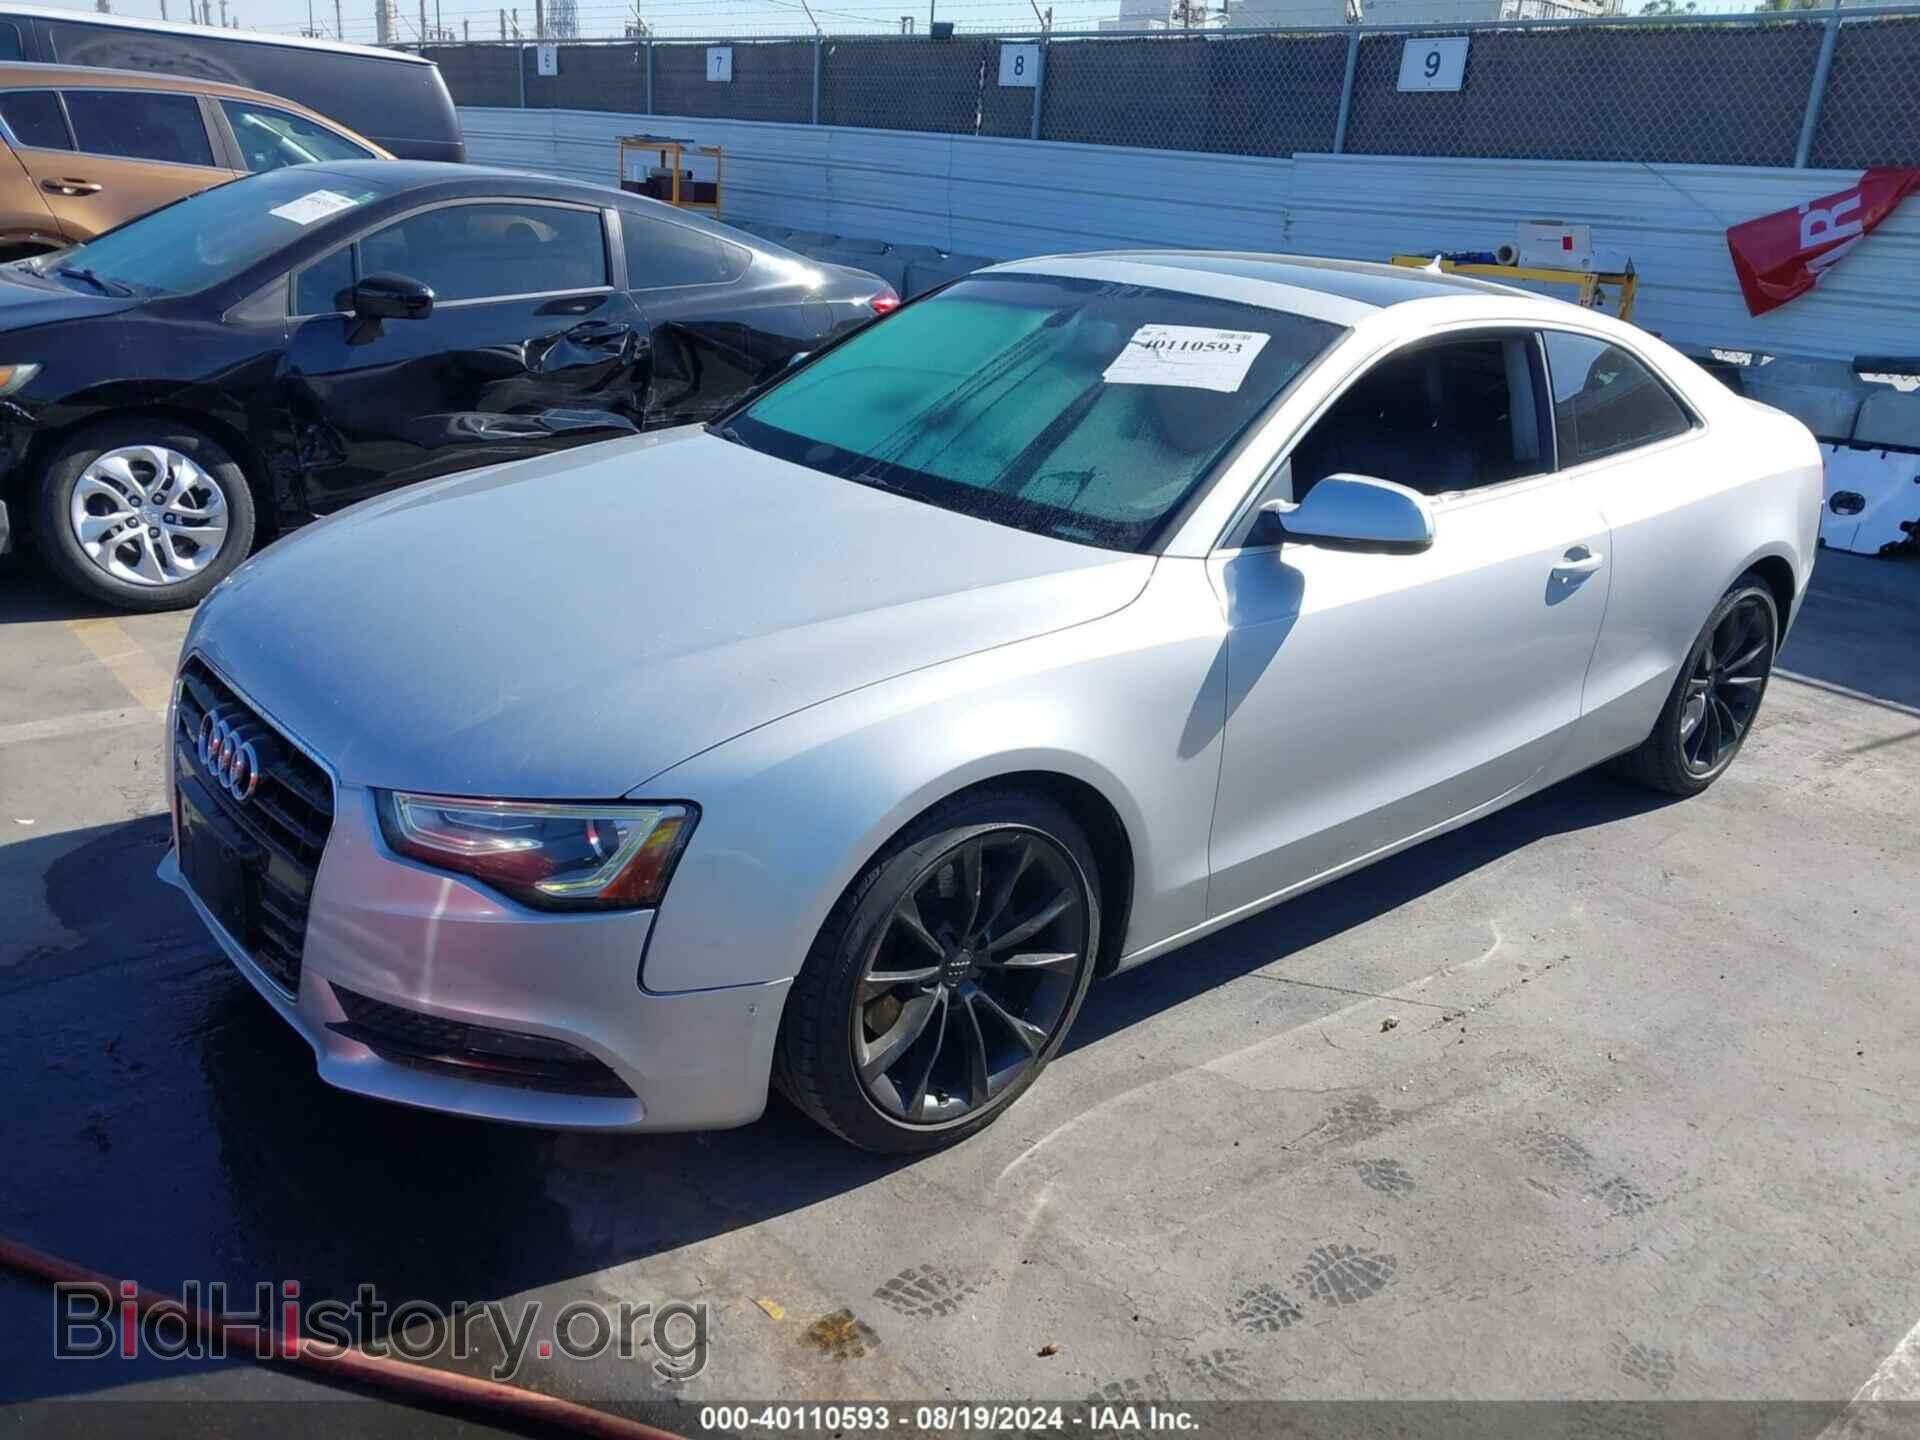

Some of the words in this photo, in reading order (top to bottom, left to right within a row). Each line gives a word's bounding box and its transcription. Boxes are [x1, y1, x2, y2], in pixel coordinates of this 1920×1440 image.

[544, 53, 551, 69] 6
[715, 55, 723, 73] 7
[1014, 55, 1024, 76] 8
[1424, 51, 1441, 78] 9
[1144, 339, 1243, 354] 40110593
